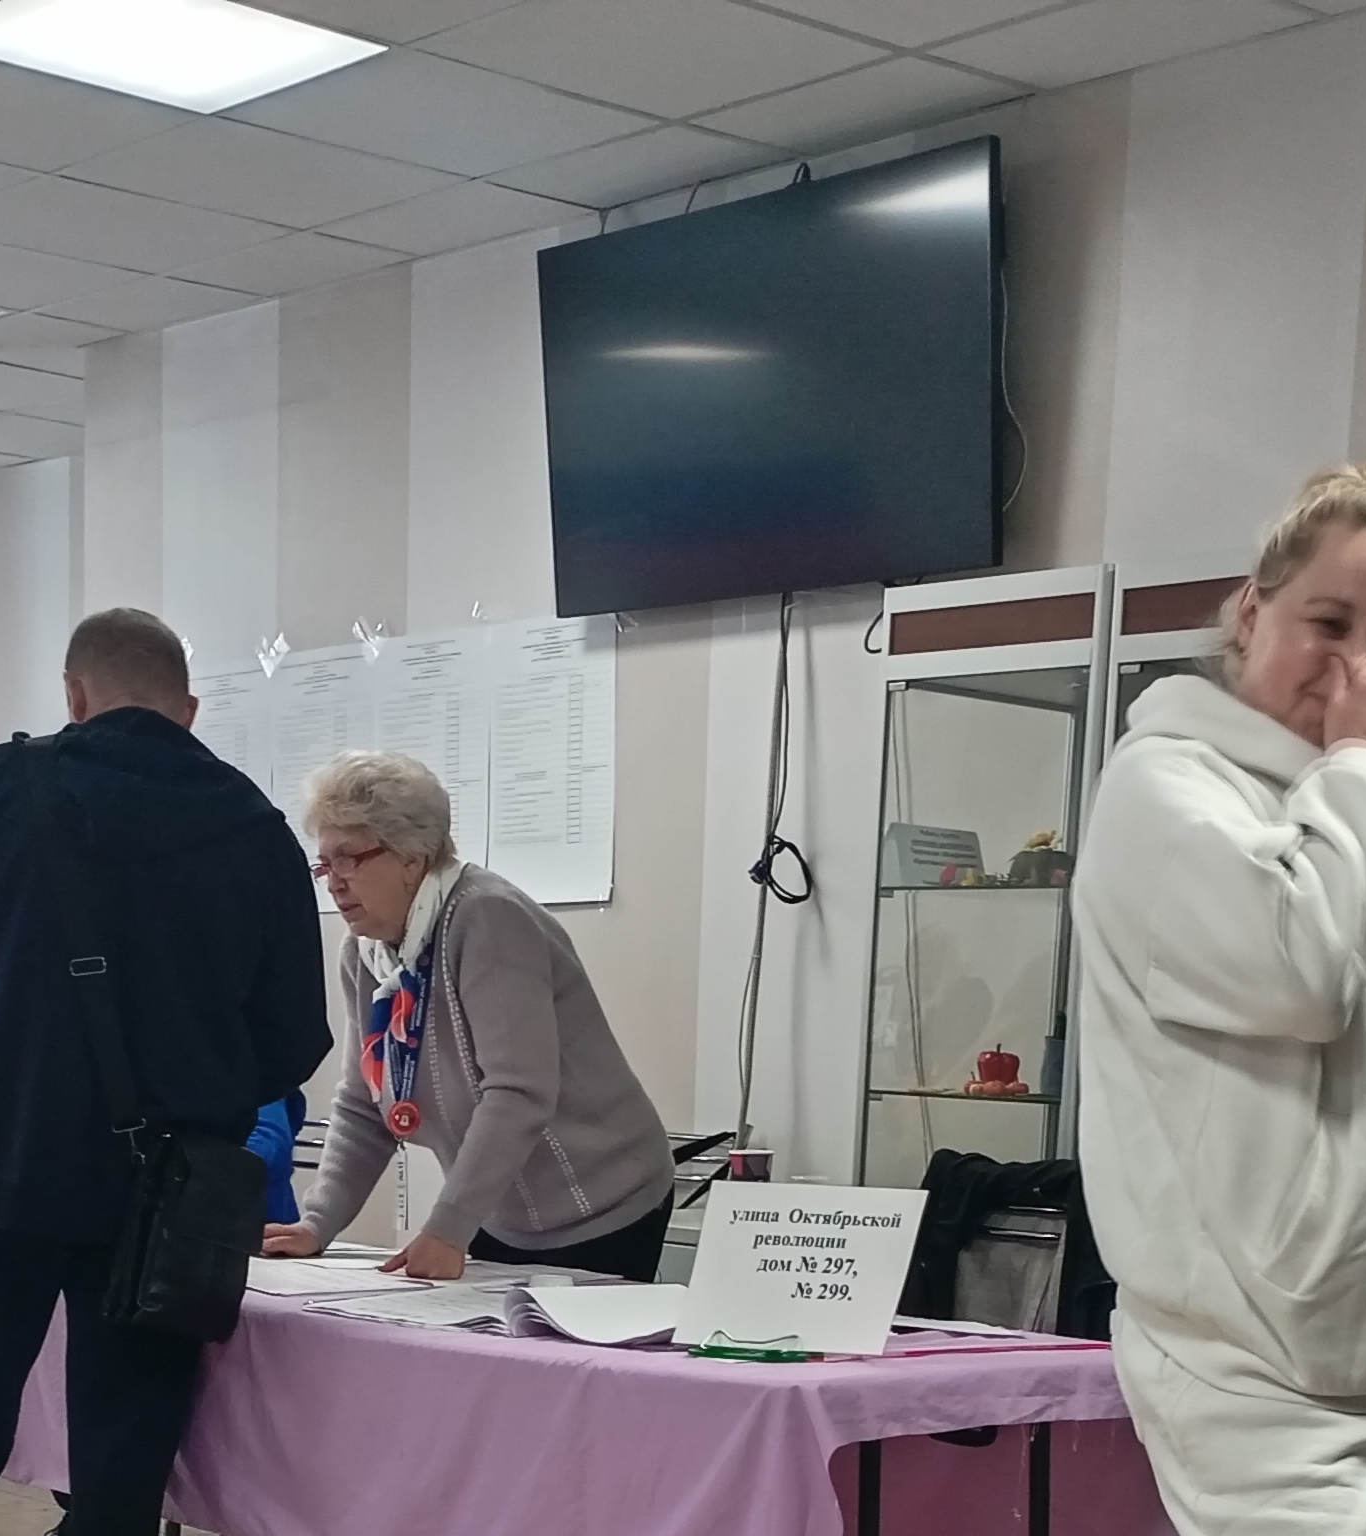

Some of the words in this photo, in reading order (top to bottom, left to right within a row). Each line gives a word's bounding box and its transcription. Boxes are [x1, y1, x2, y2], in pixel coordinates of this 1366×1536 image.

[729, 1208, 779, 1225] улица
[789, 1207, 901, 1229] Октябрьской
[753, 1232, 846, 1249] революции
[756, 1258, 791, 1273] дом
[795, 1256, 818, 1273] №
[822, 1257, 858, 1278] 297,
[791, 1282, 813, 1298] №
[816, 1282, 852, 1301] 299.
